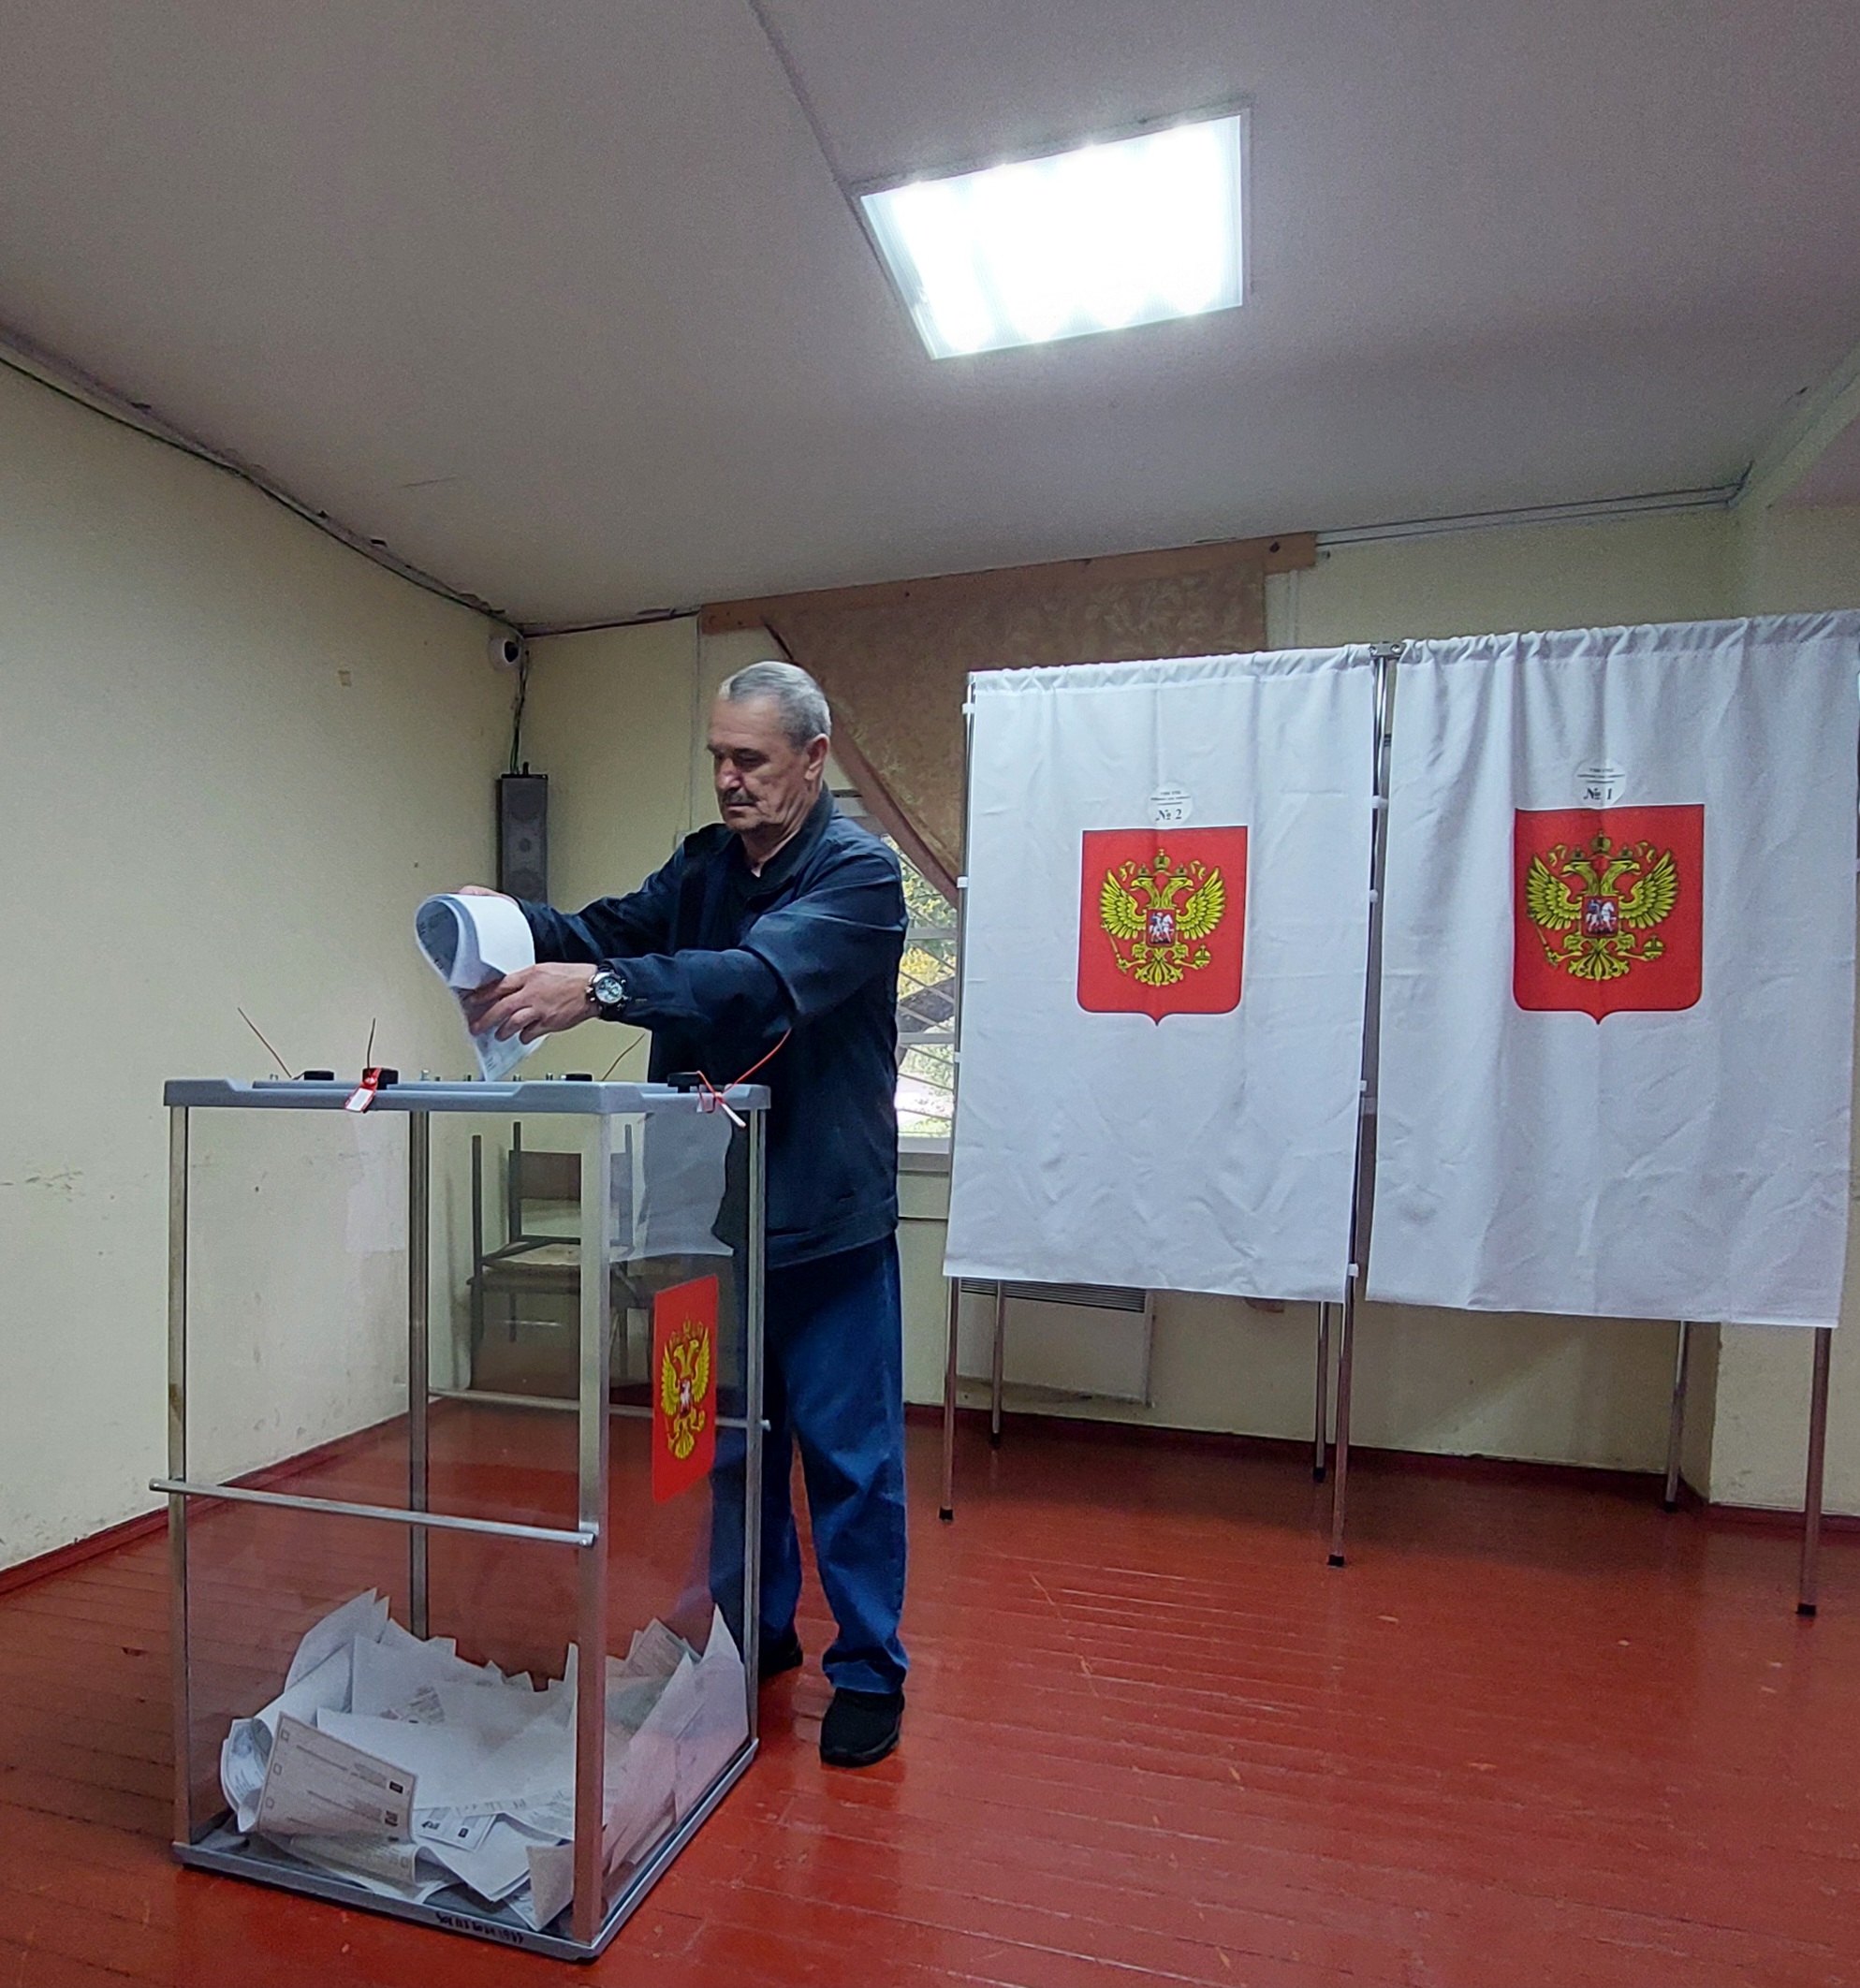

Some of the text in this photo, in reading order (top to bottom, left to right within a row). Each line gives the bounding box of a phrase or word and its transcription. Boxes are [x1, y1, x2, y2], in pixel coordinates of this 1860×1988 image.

[1583, 786, 1613, 800] № 1
[1155, 808, 1182, 822] № 2
